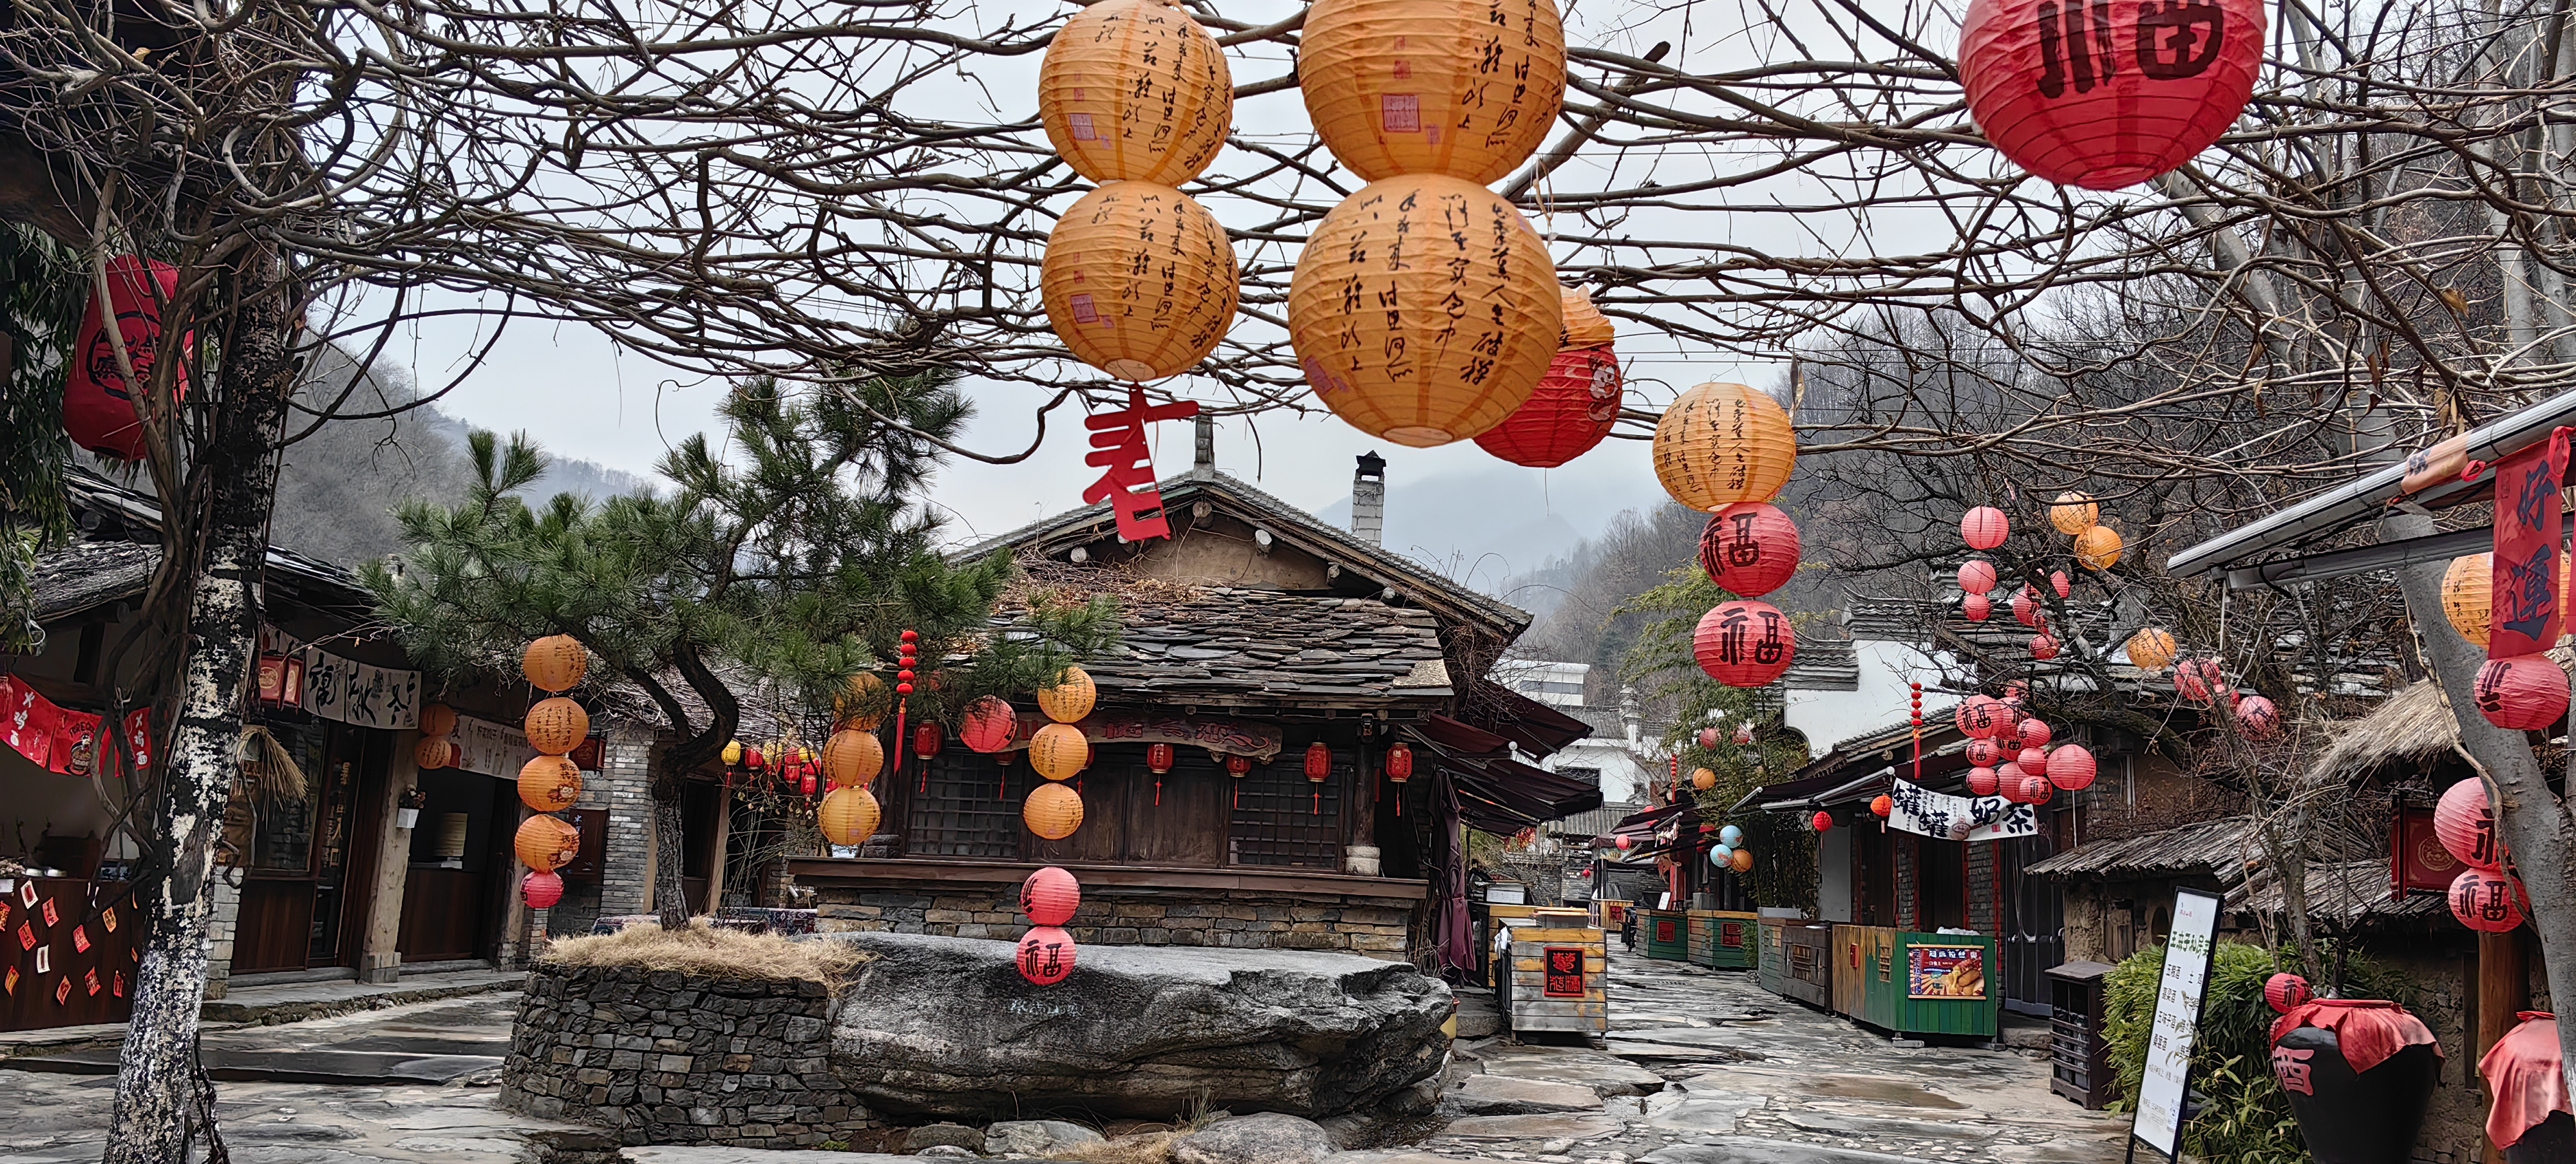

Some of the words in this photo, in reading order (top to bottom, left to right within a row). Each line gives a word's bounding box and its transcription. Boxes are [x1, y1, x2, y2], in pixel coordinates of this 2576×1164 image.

[1702, 512, 1759, 577] 福
[1719, 607, 1784, 666] 福
[10, 691, 35, 747] 火鸡面
[133, 713, 148, 765] 火鸡面
[1962, 705, 1992, 731] 福
[1893, 783, 2034, 838] 罐罐奶茶
[2459, 874, 2508, 922] 福
[1025, 939, 1062, 977] 福
